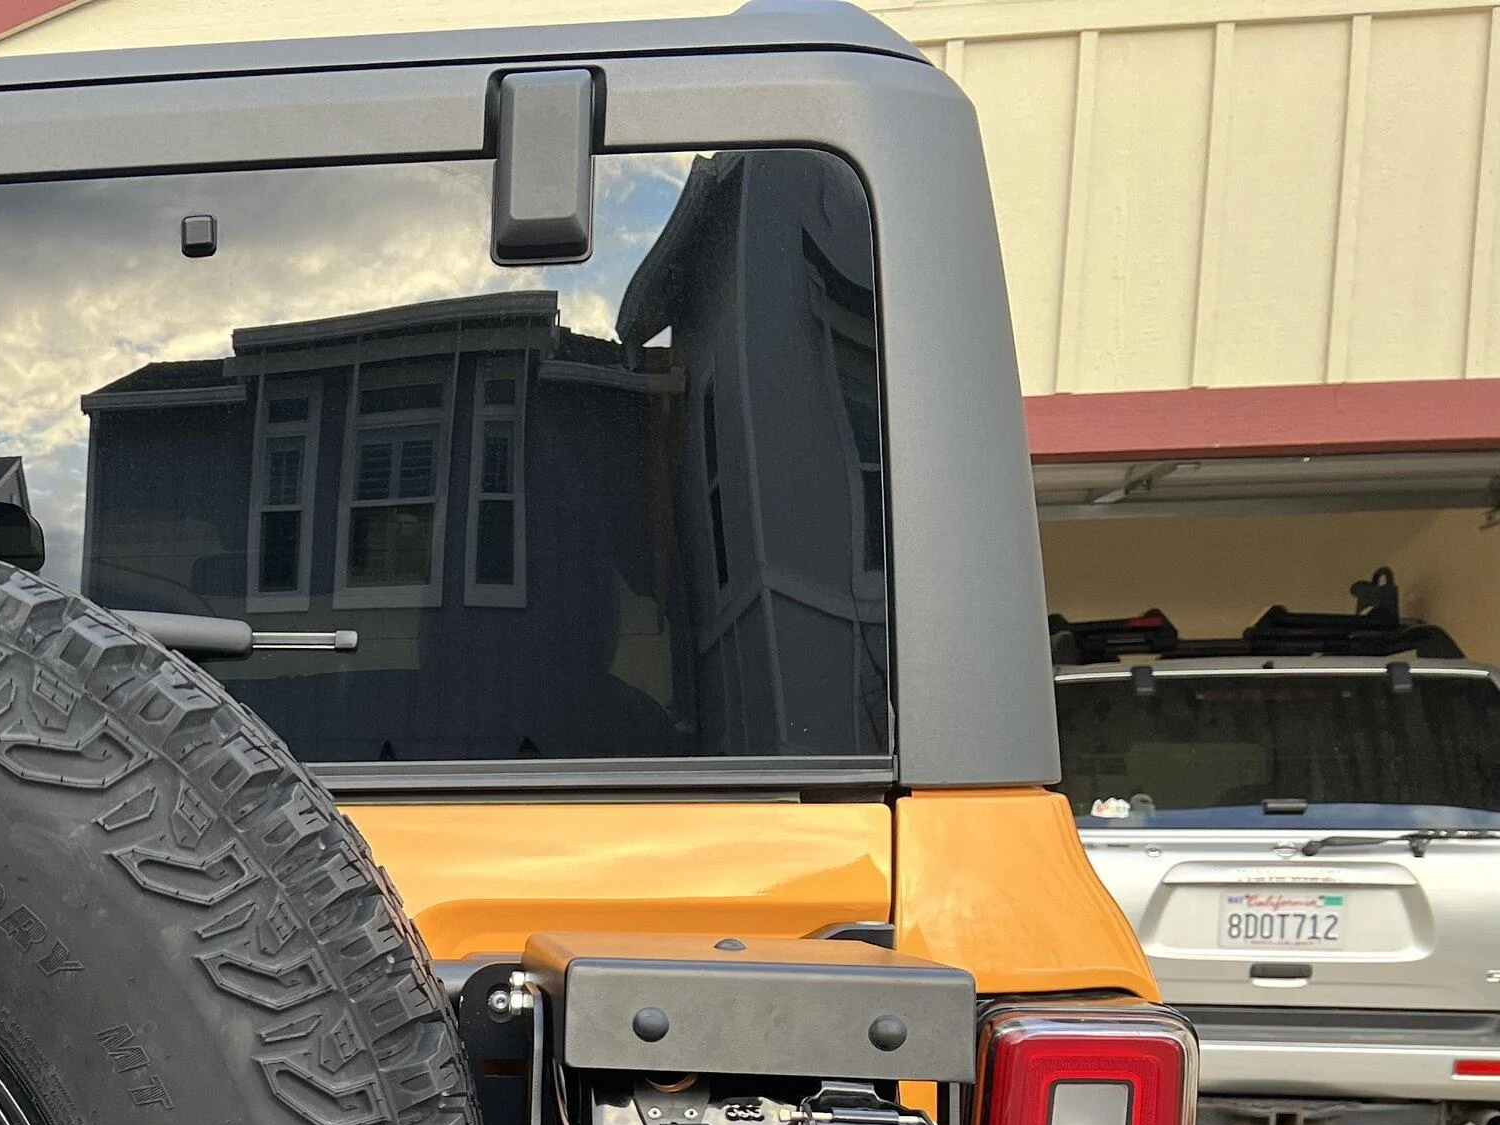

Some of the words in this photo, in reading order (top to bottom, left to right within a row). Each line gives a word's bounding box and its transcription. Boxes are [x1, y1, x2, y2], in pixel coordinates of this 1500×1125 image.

[1245, 893, 1320, 911] California
[1227, 912, 1340, 941] 8DOT712
[96, 1023, 174, 1110] MT
